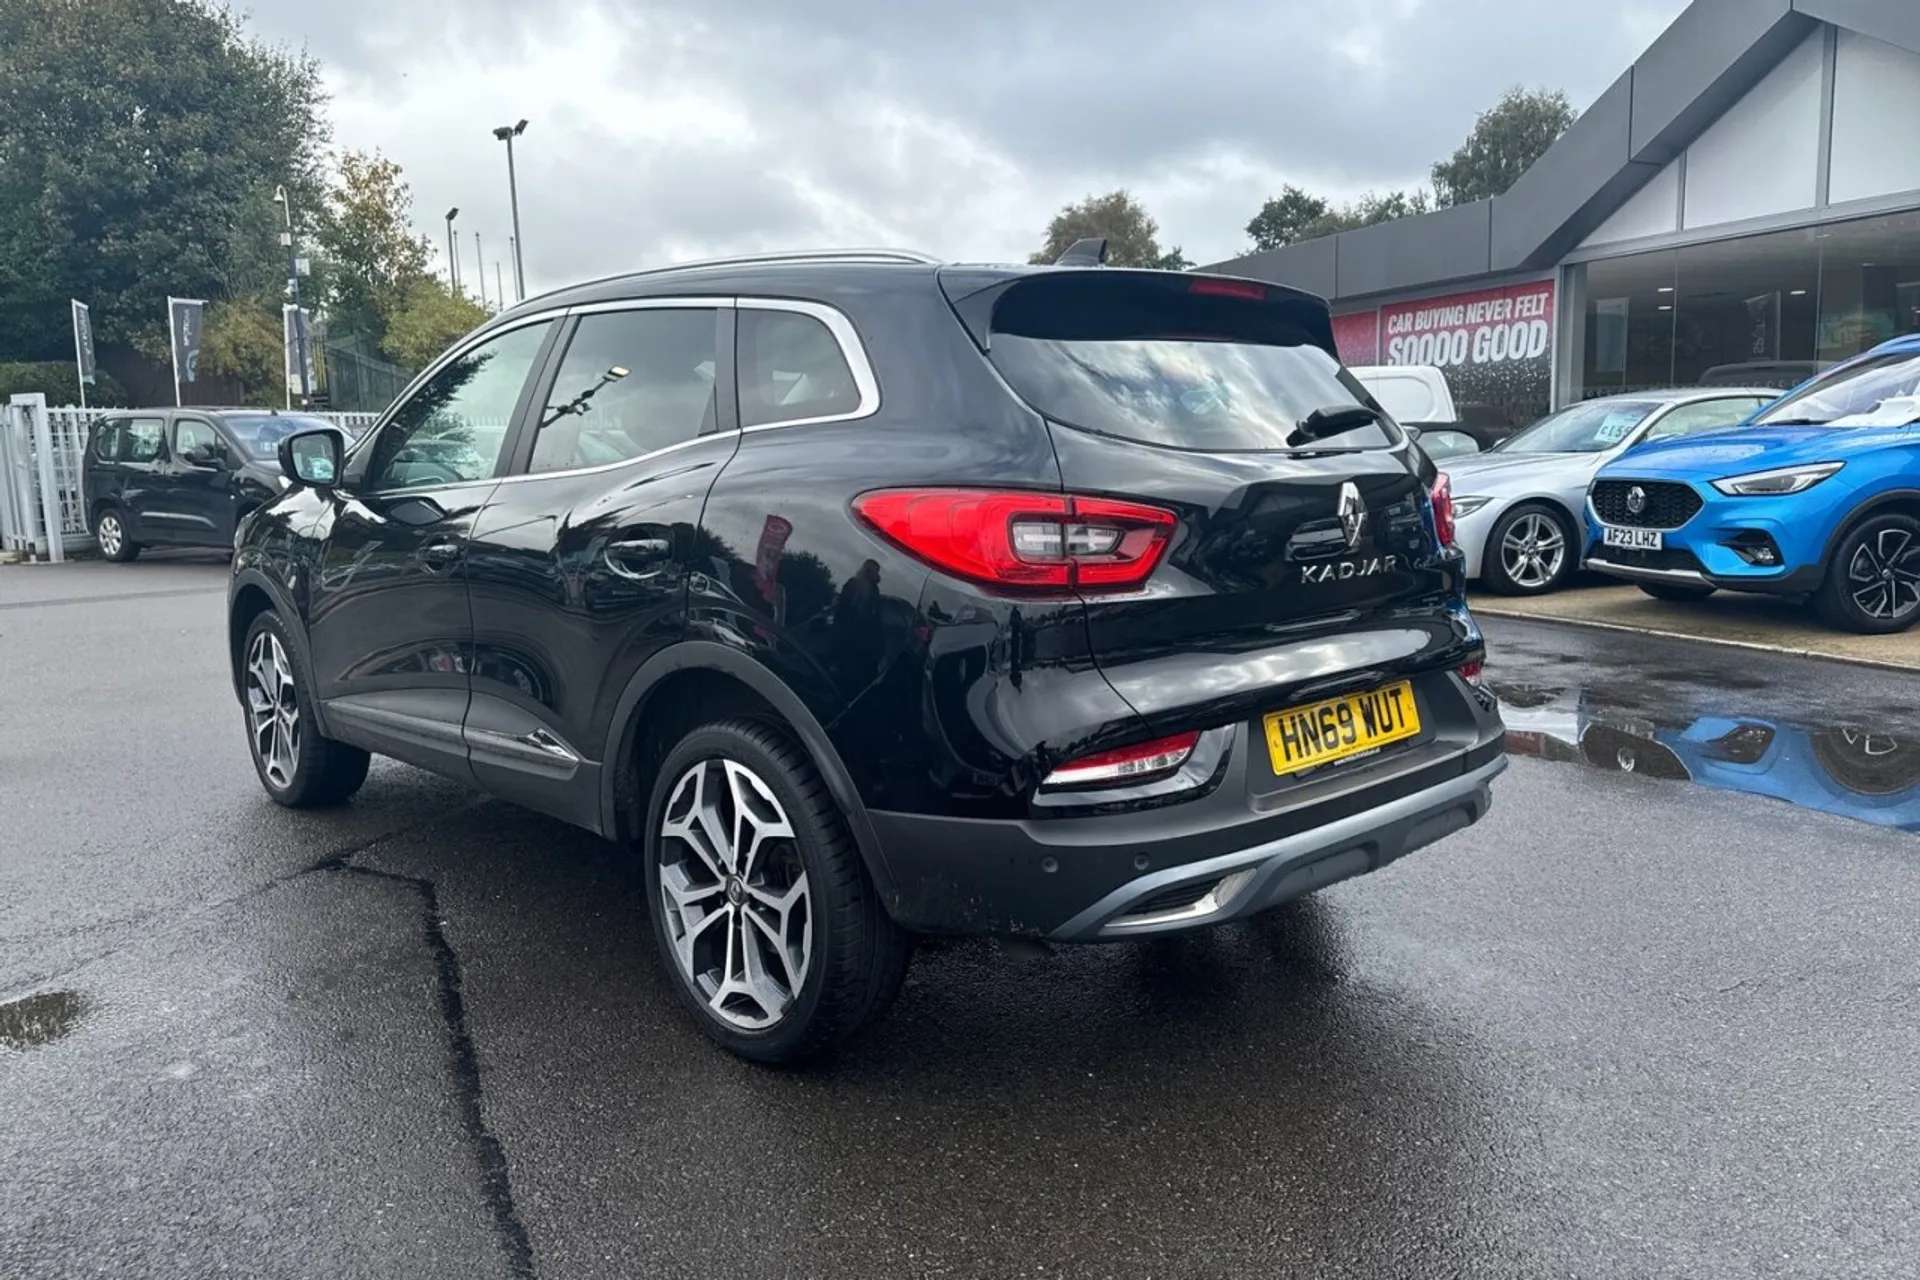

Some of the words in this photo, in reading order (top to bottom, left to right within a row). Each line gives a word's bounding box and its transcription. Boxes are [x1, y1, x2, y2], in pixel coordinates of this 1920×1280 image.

[1387, 313, 1413, 334] CAR
[1414, 305, 1465, 331] BUYING
[1465, 298, 1513, 325] NEVER
[1514, 292, 1549, 318] FELT
[1387, 328, 1469, 367] SOOOO
[1472, 319, 1548, 364] GOOD
[1607, 529, 1634, 545] AF23
[1635, 530, 1658, 547] LHZ
[1301, 555, 1397, 584] KADJAR
[1278, 702, 1358, 762] HN69
[1357, 687, 1406, 739] WUT
